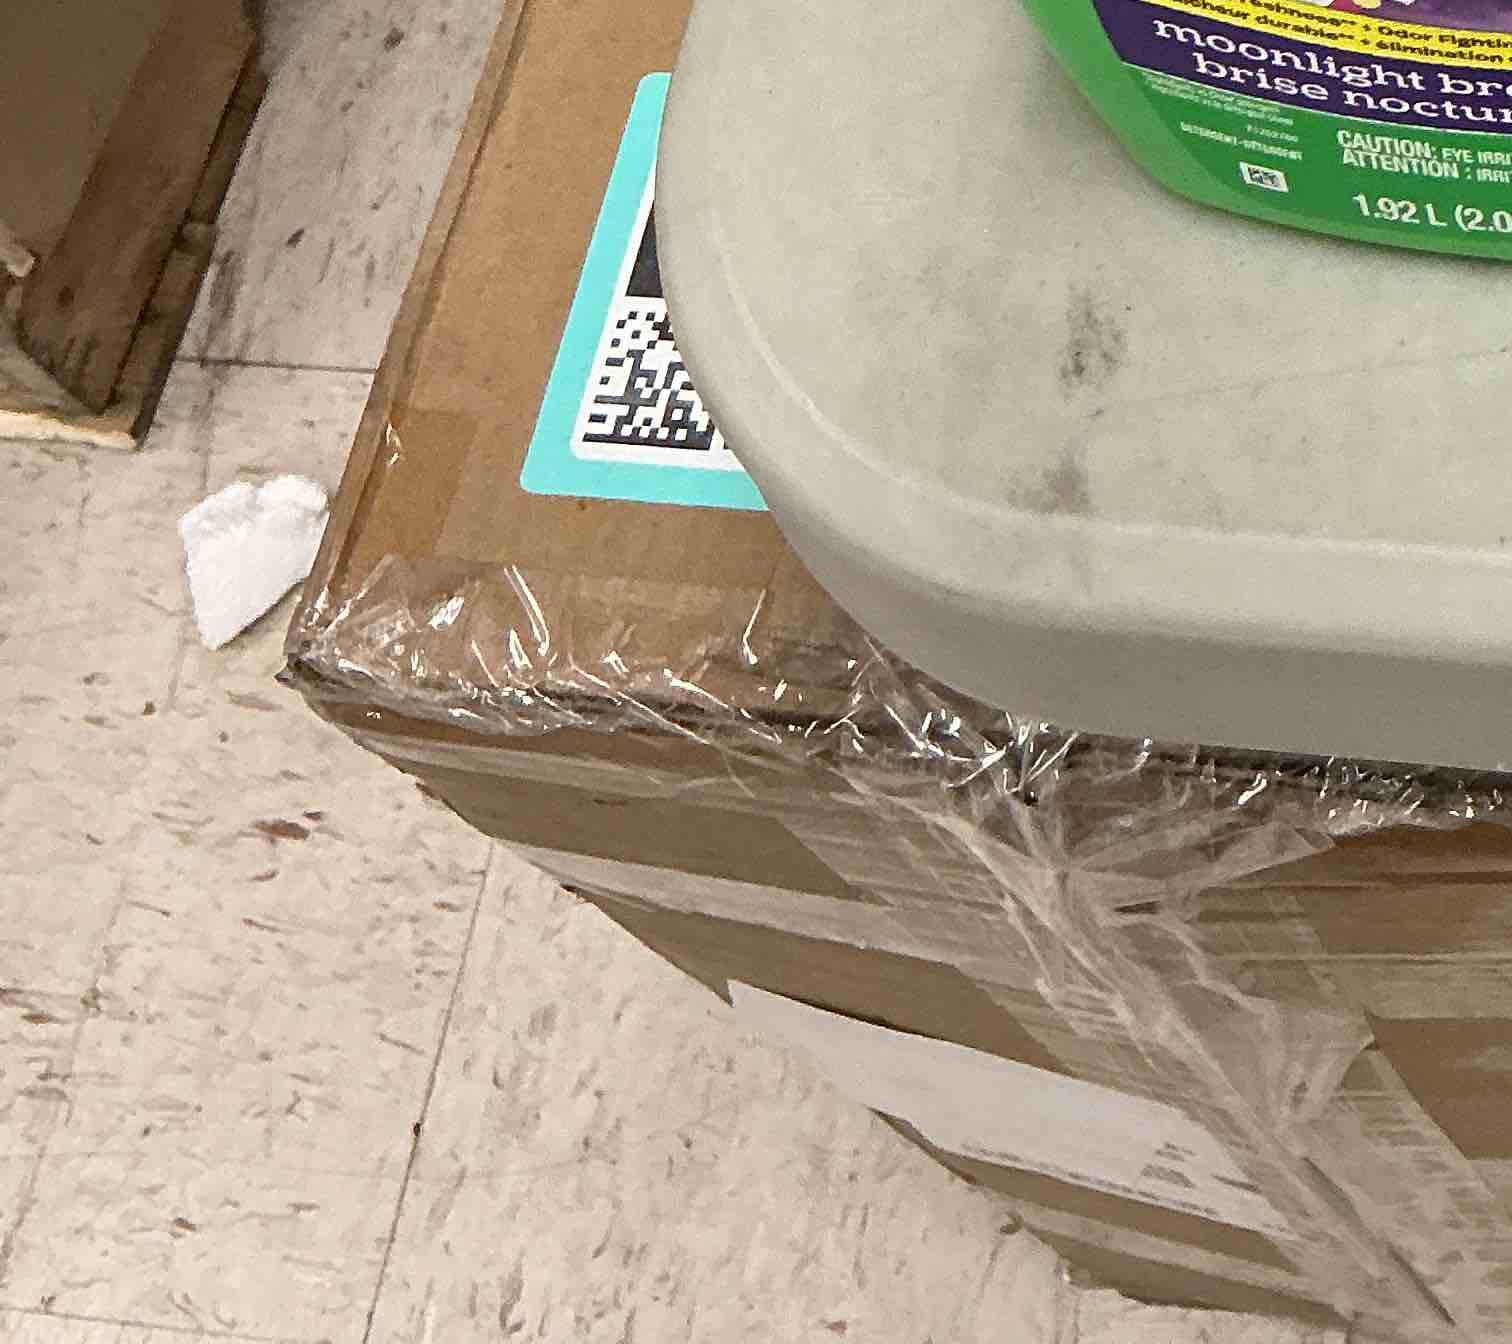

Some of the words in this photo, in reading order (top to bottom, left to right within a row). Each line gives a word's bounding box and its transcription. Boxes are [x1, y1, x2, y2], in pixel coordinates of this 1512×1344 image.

[1377, 23, 1433, 42] Odor
[1152, 18, 1427, 92] moonlight
[1191, 51, 1329, 101] brise
[1336, 129, 1438, 161] CAUTION:
[1442, 147, 1474, 164] EYE
[1342, 146, 1460, 180] ATTENTION
[1353, 191, 1421, 225] 1.92
[1425, 202, 1449, 227] L
